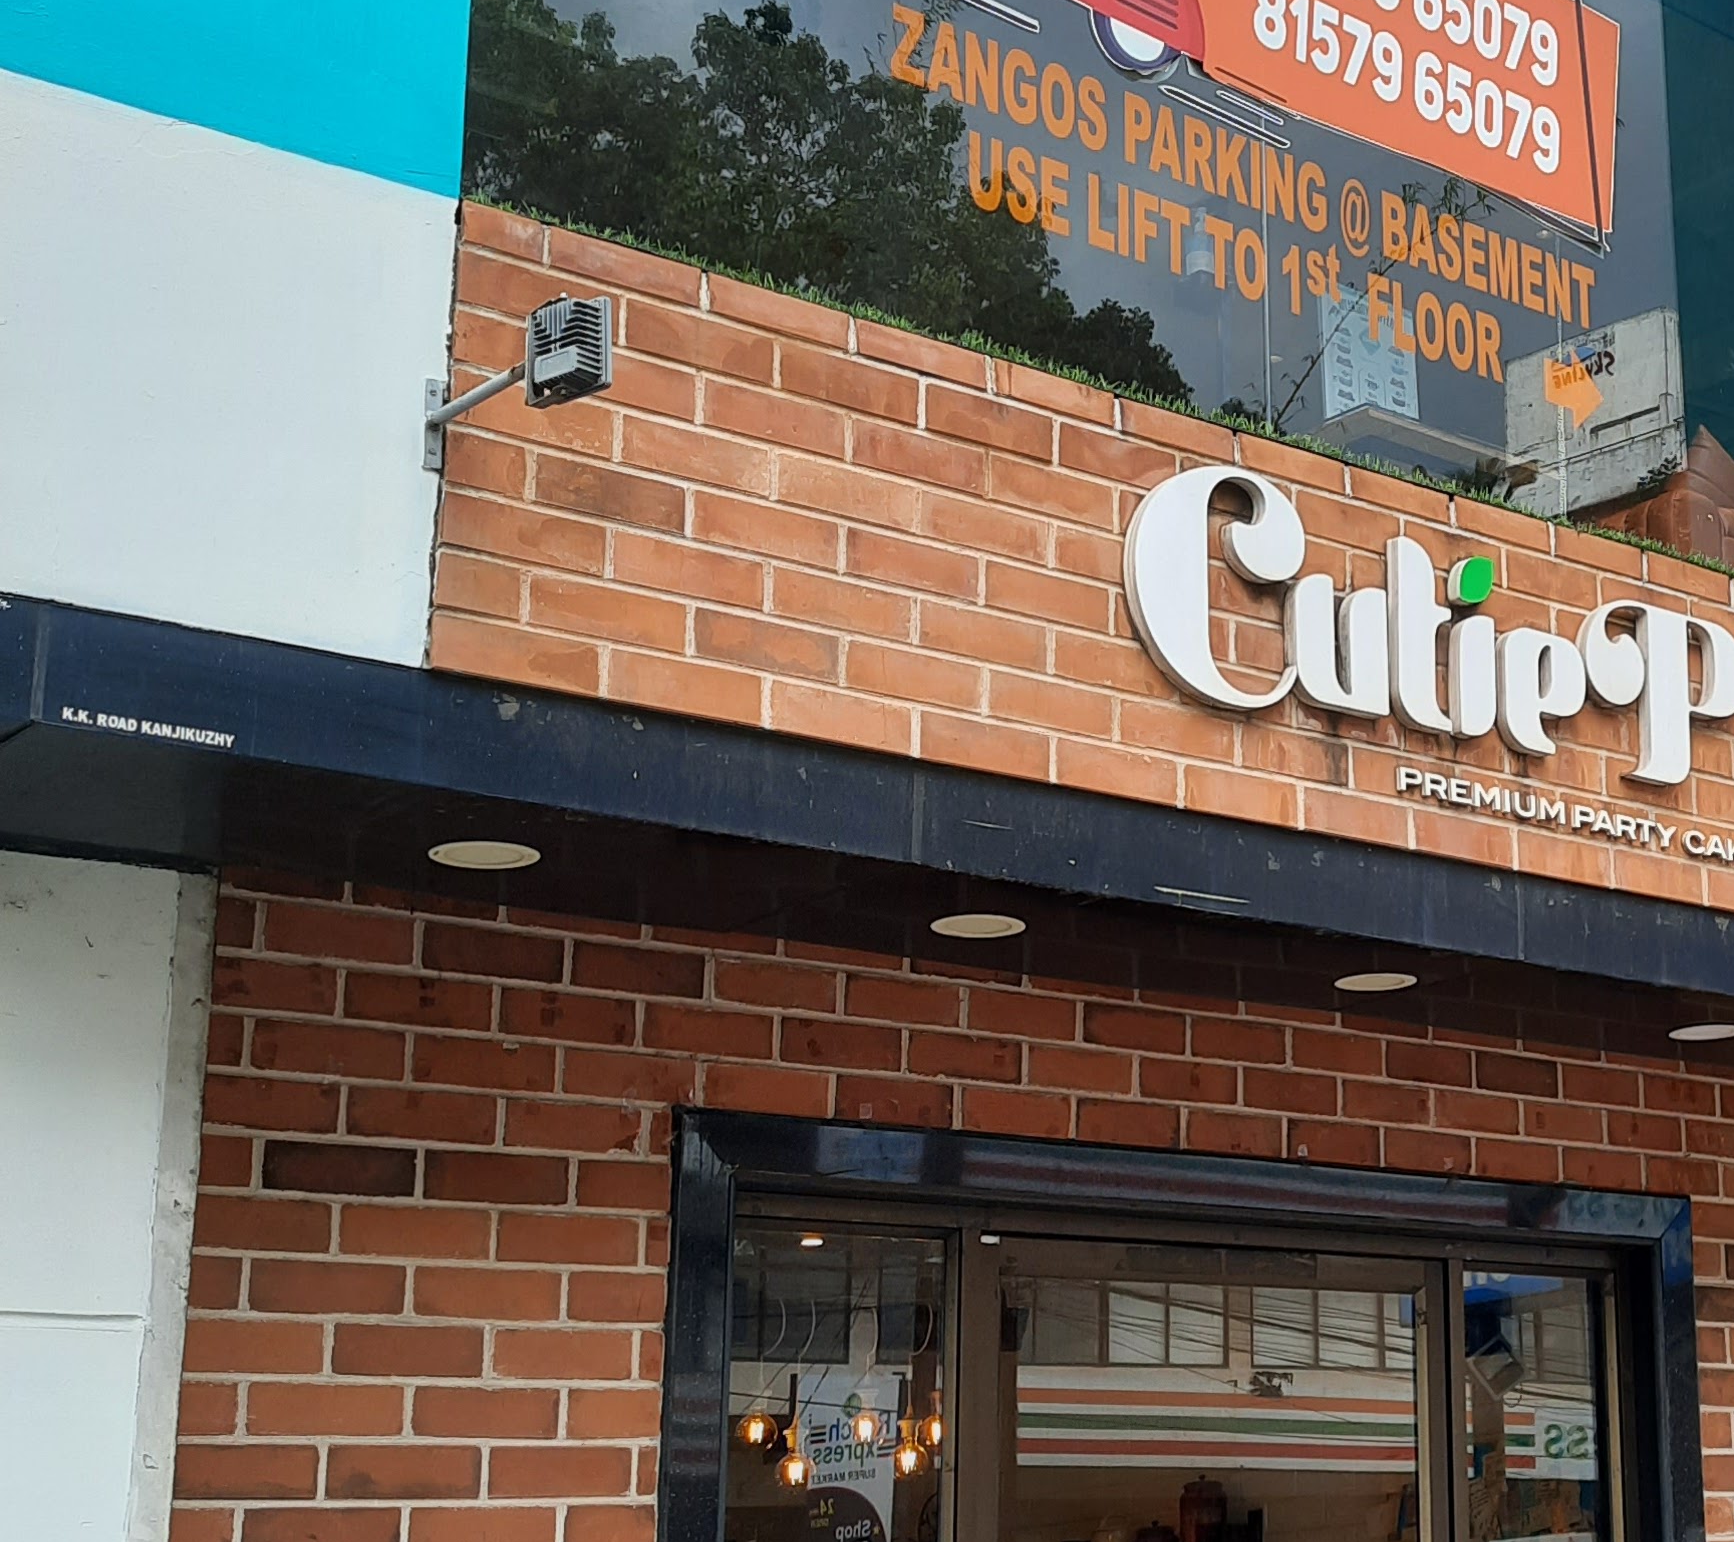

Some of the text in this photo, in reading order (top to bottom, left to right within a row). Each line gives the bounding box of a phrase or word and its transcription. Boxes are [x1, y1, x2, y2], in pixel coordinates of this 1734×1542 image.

[890, 2, 1596, 329] ZANGOS PARKING @ BASEMENT
[1414, 52, 1561, 174] 65079
[967, 130, 1073, 236] USE
[1086, 170, 1191, 276] LIFT
[1204, 213, 1265, 300] TO
[1282, 244, 1342, 316] 1st
[1366, 272, 1504, 384] FLOOR
[62, 706, 235, 748] K.K. ROAD KANJIKUZHY
[1396, 765, 1566, 829] PREMIUM
[1570, 804, 1678, 855] PARTY
